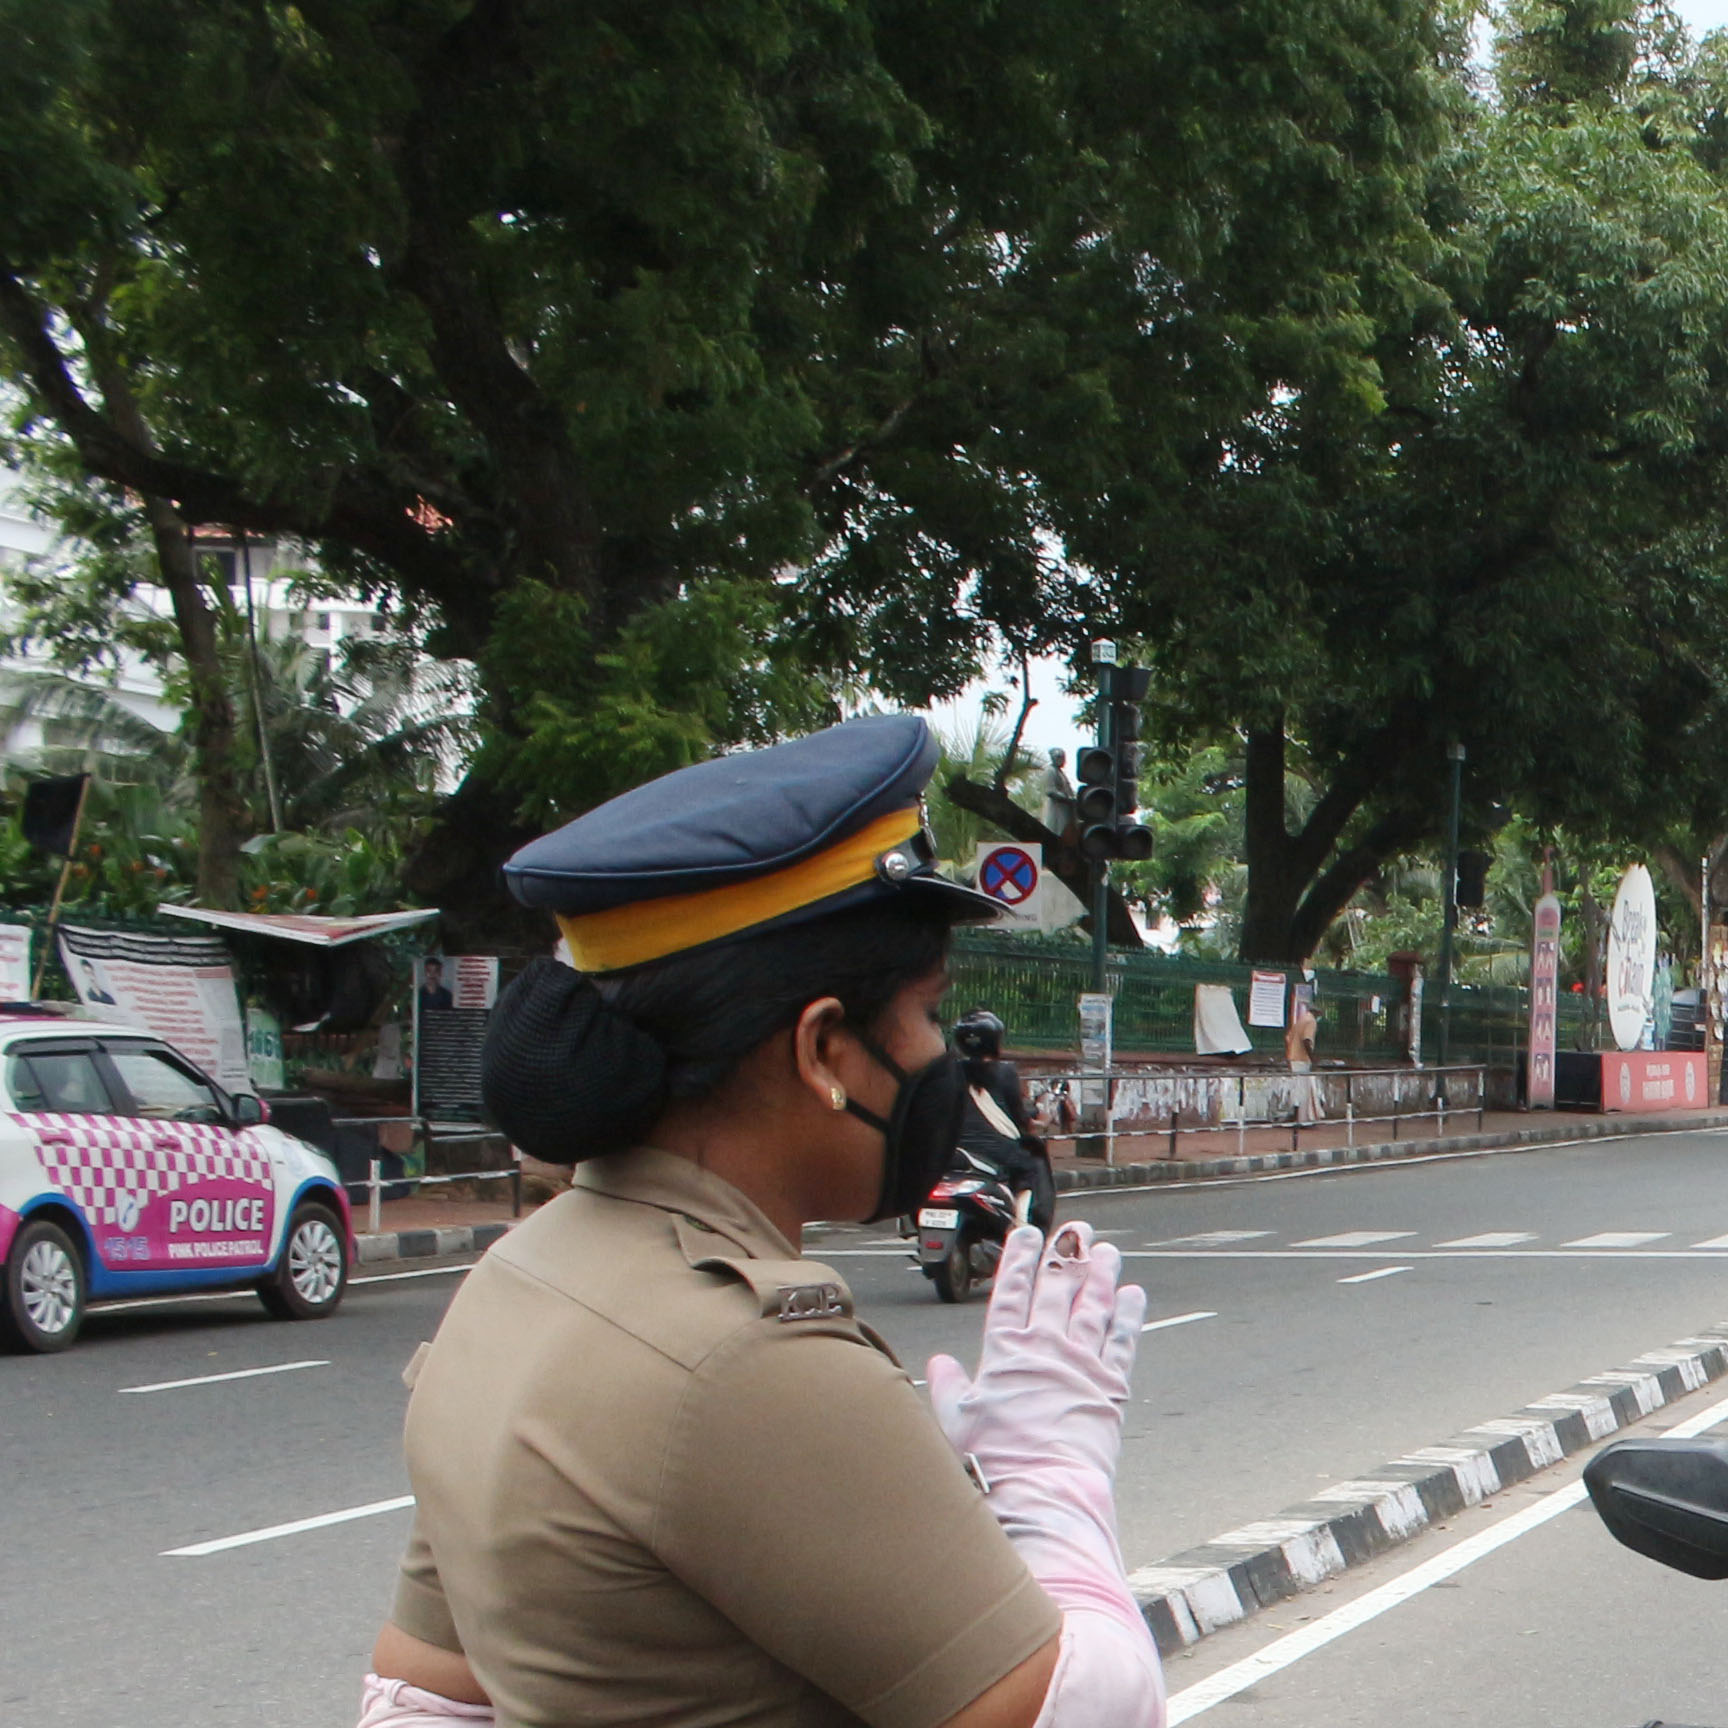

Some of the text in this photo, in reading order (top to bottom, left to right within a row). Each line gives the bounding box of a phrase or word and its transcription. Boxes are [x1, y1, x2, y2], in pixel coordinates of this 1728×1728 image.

[169, 1198, 264, 1233] POLICE
[168, 1239, 264, 1259] PINK POLICE PATROL
